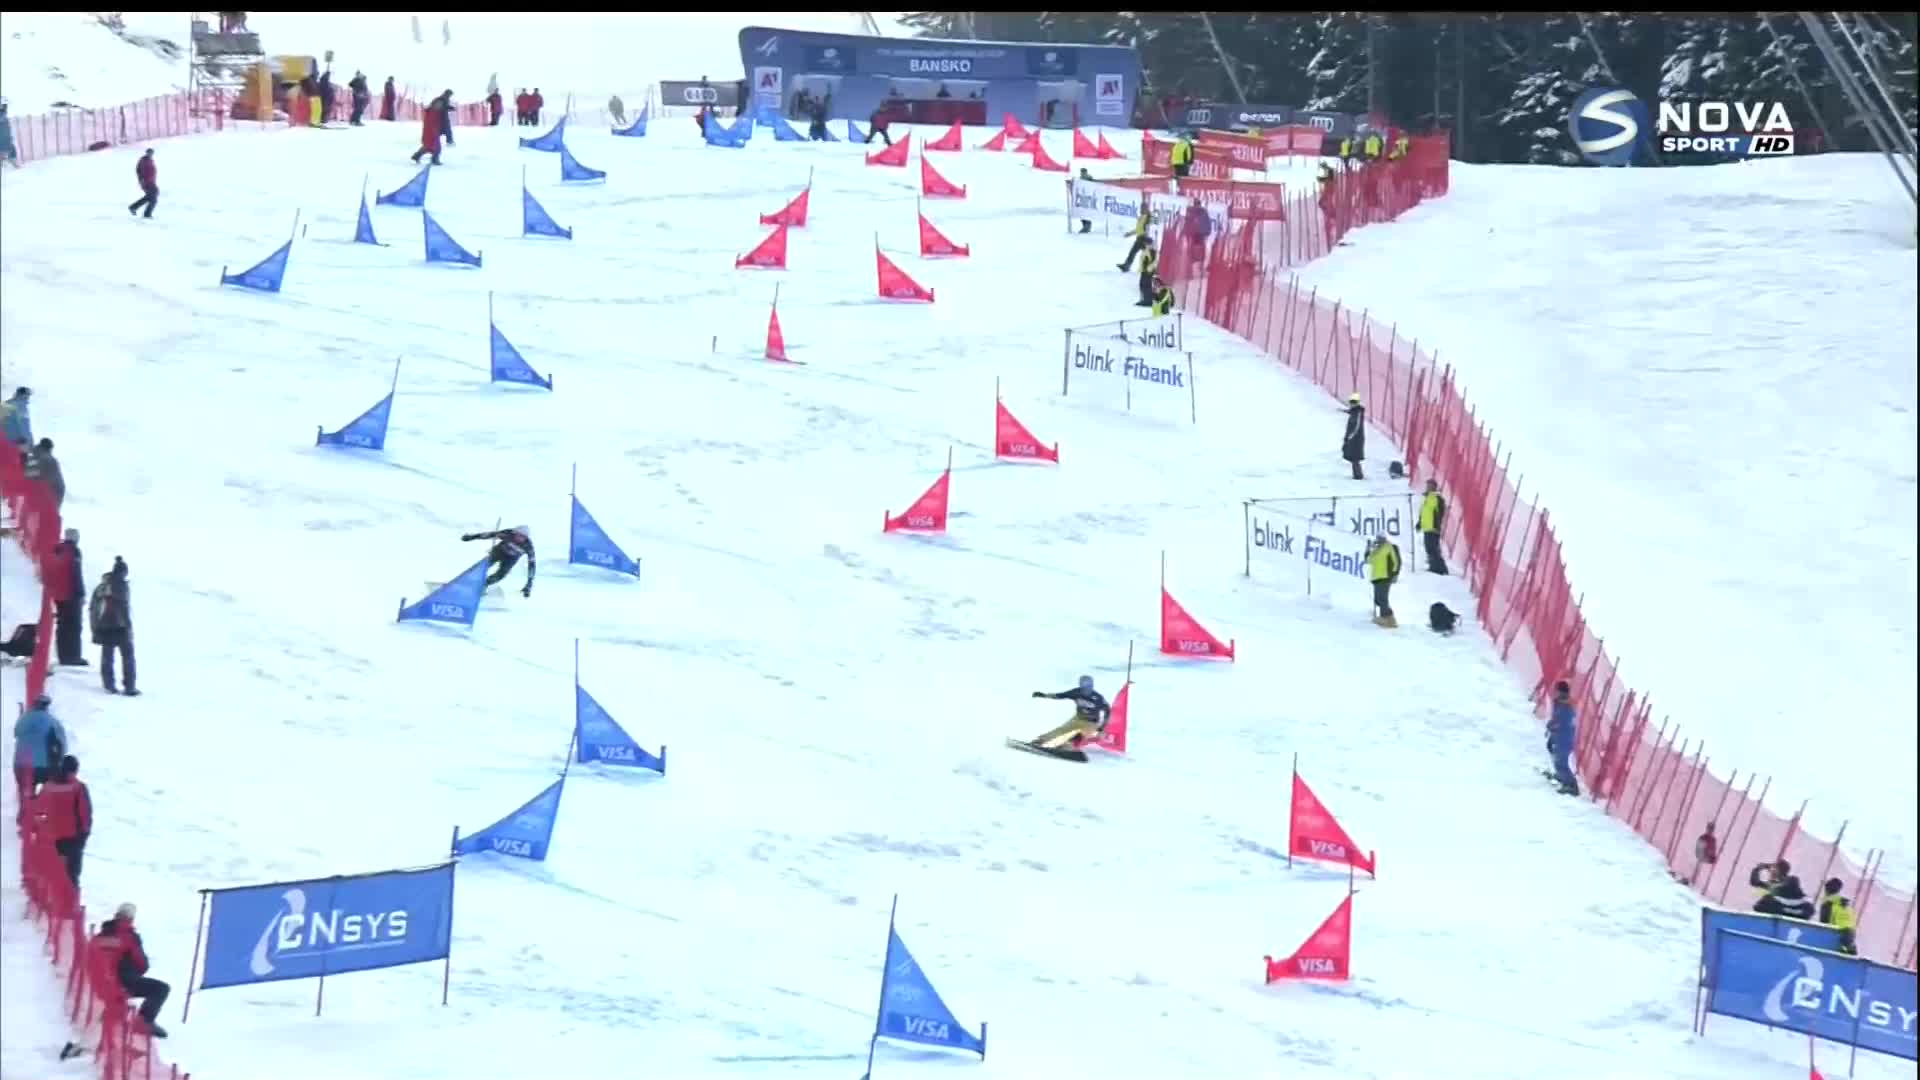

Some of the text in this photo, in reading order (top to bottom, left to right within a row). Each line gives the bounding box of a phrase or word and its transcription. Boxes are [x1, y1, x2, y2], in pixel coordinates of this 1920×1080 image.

[909, 58, 972, 73] BANSKO
[1103, 195, 1138, 218] Fibank
[1074, 343, 1184, 388] blink Fibank
[1254, 517, 1365, 579] blink Fibank
[585, 549, 614, 565] VISA
[431, 603, 464, 618] VISA
[1179, 640, 1210, 652] VISA
[598, 745, 636, 760] VISA
[492, 837, 532, 856] VISA
[1310, 839, 1346, 858] VISA
[1297, 958, 1336, 973] VISA
[904, 1015, 949, 1040] VISA
